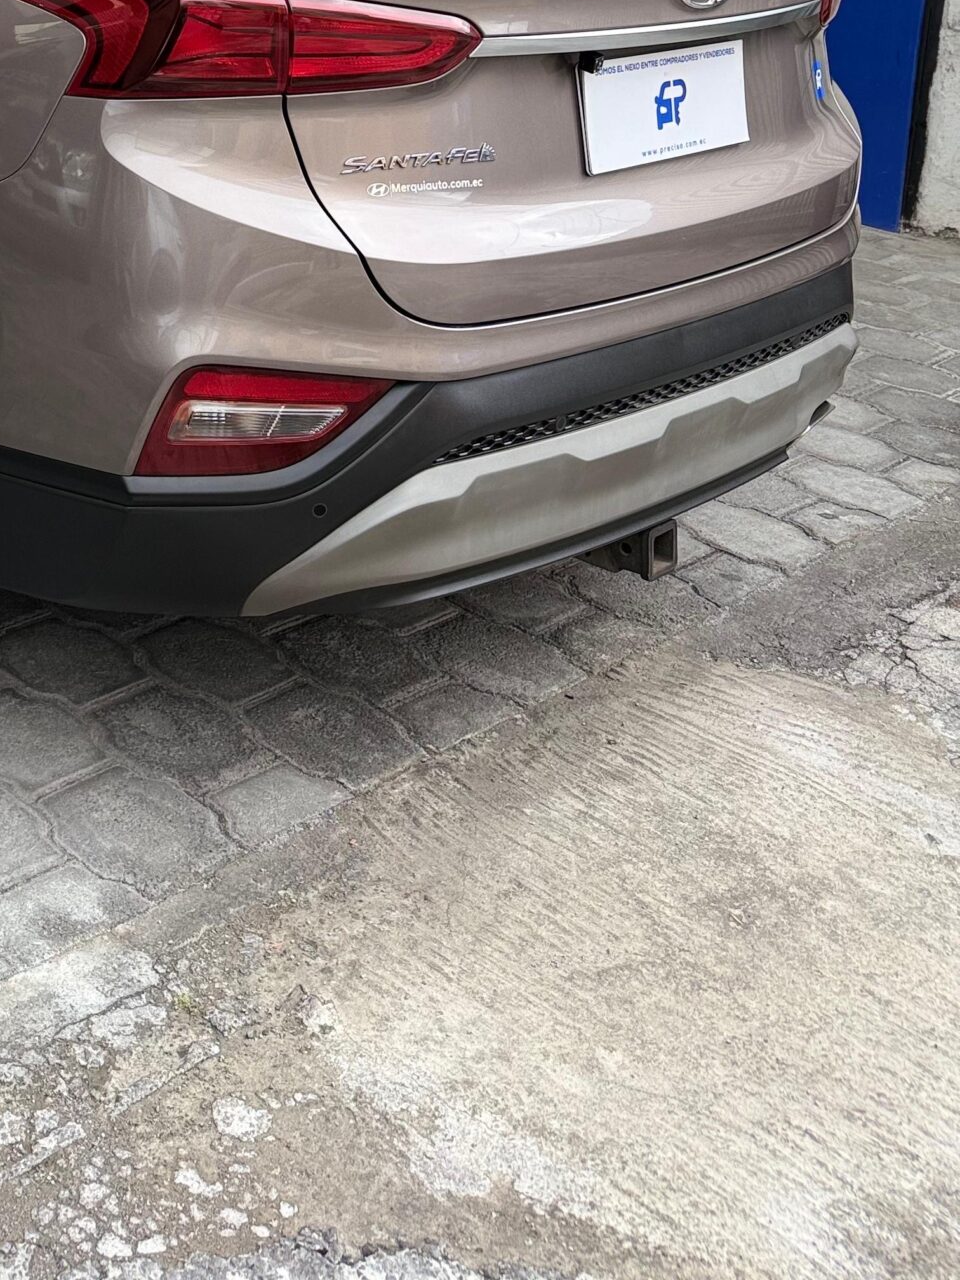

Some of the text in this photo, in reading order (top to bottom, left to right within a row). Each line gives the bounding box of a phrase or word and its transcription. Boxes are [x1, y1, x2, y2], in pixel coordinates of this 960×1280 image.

[617, 65, 624, 73] EL
[625, 62, 640, 72] NEXO
[641, 59, 658, 70] ENTRE
[659, 53, 698, 66] COMPRADORES
[704, 47, 735, 59] VENDEDORES
[391, 178, 484, 194] Merquiauto.com.ec
